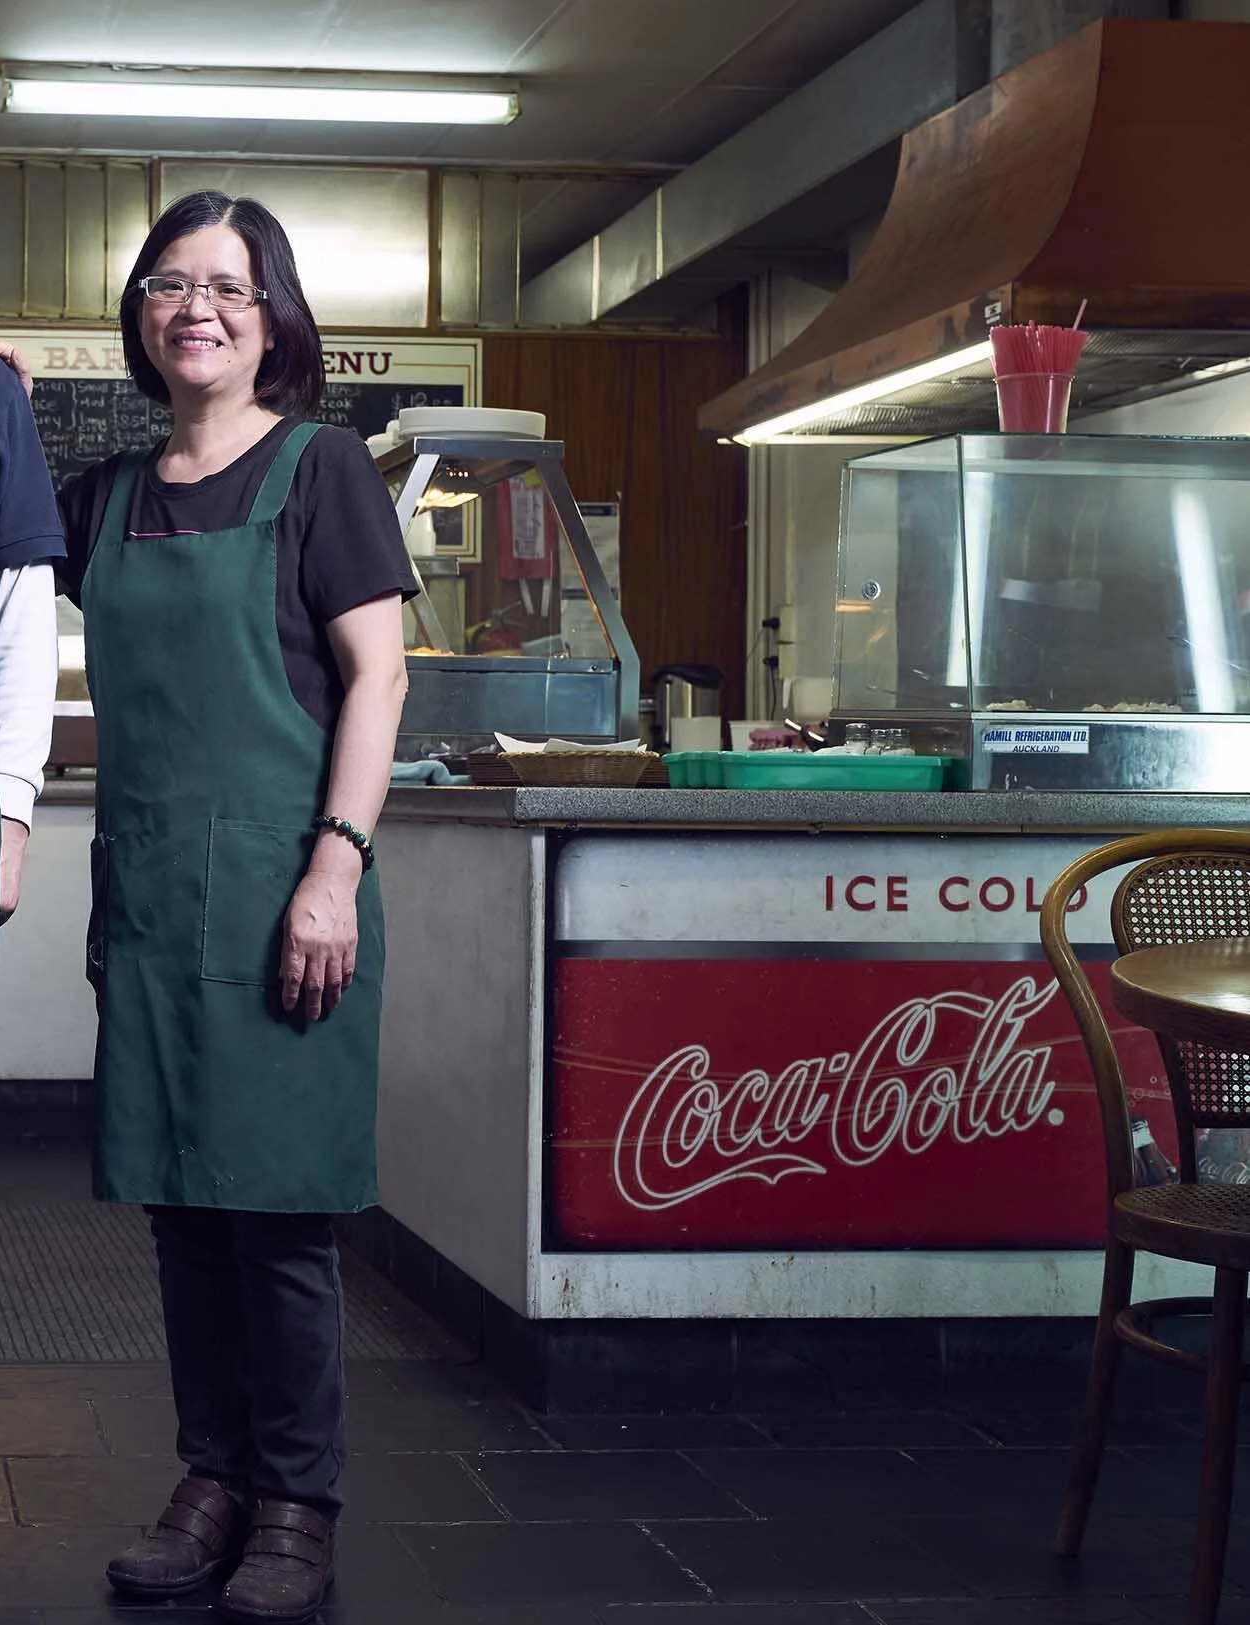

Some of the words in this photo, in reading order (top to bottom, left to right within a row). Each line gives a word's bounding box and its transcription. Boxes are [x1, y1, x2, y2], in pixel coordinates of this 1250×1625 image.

[323, 351, 393, 375] ENU
[984, 730, 1012, 742] HAMILL
[1014, 730, 1071, 742] REFRIGERATION
[1072, 730, 1088, 742] LTD.
[1012, 744, 1060, 753] AUCKLAND
[824, 874, 909, 912] ICE
